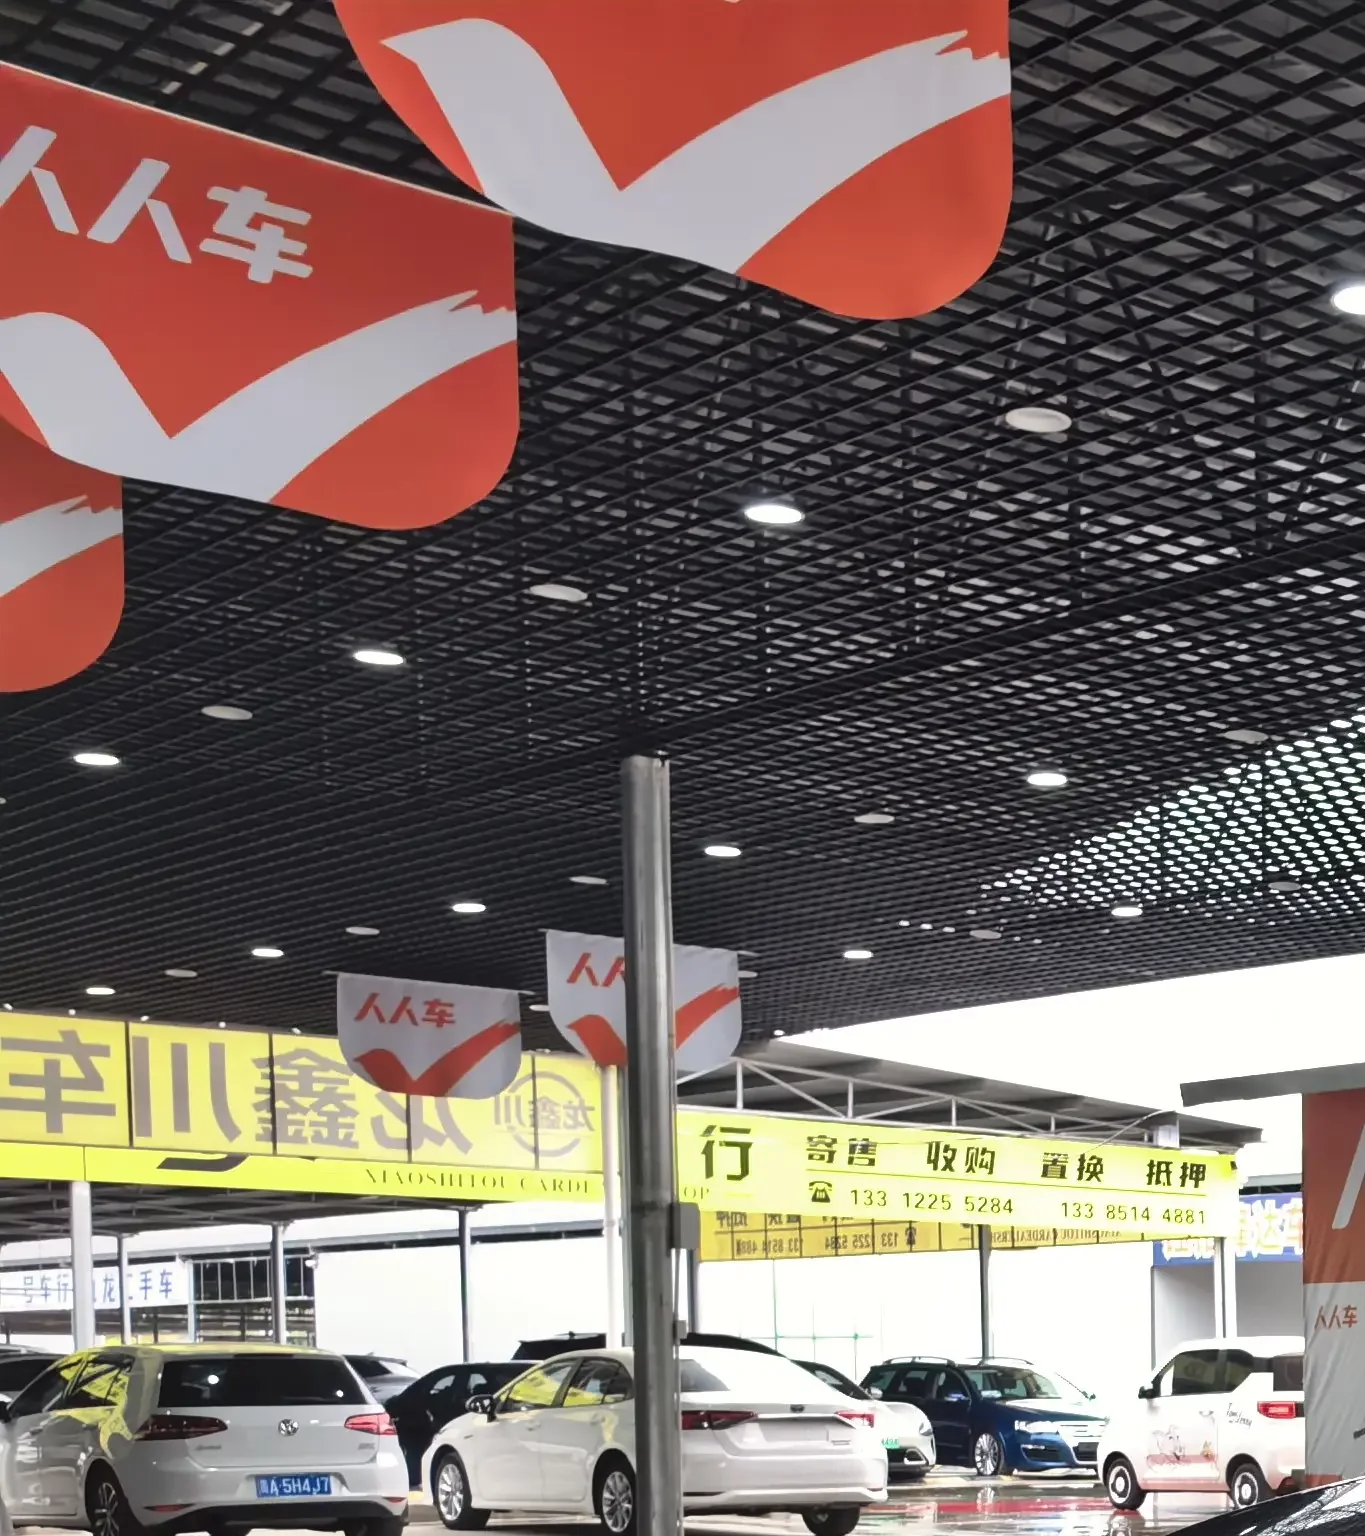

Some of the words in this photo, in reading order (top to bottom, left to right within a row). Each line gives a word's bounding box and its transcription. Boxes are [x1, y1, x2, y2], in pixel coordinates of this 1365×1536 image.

[0, 125, 313, 284] 人人车
[354, 992, 456, 1029] 人人车
[700, 1125, 753, 1181] 行
[806, 1135, 877, 1167] 寄售
[926, 1140, 996, 1175] 收购
[1041, 1152, 1105, 1182] 置换
[1146, 1159, 1207, 1188] 抵押
[850, 1189, 888, 1207] 133
[902, 1192, 952, 1211] 1225
[964, 1195, 1014, 1214] 5284
[1061, 1202, 1094, 1219] 133
[1105, 1204, 1150, 1221] 8514
[1162, 1207, 1205, 1225] 4881
[1314, 1305, 1358, 1329] 人人车
